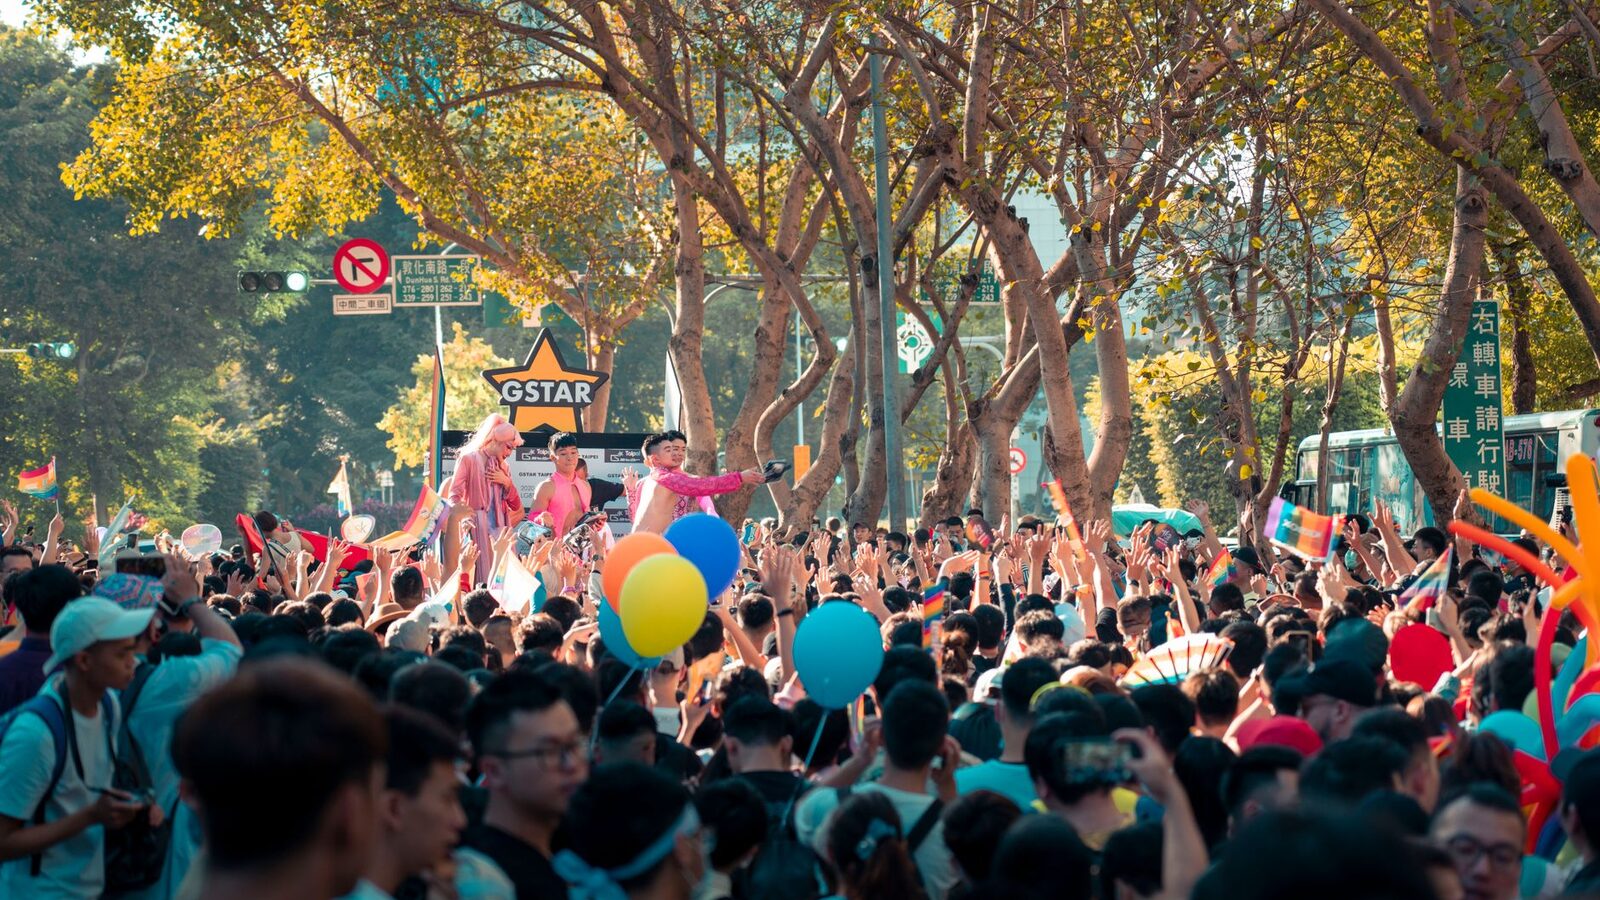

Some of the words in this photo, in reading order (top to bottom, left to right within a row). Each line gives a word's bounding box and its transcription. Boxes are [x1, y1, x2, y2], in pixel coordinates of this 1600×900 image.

[502, 380, 592, 403] GSTAR
[1447, 362, 1473, 488] 環車
[1472, 307, 1502, 495] 右轉車請行駛
